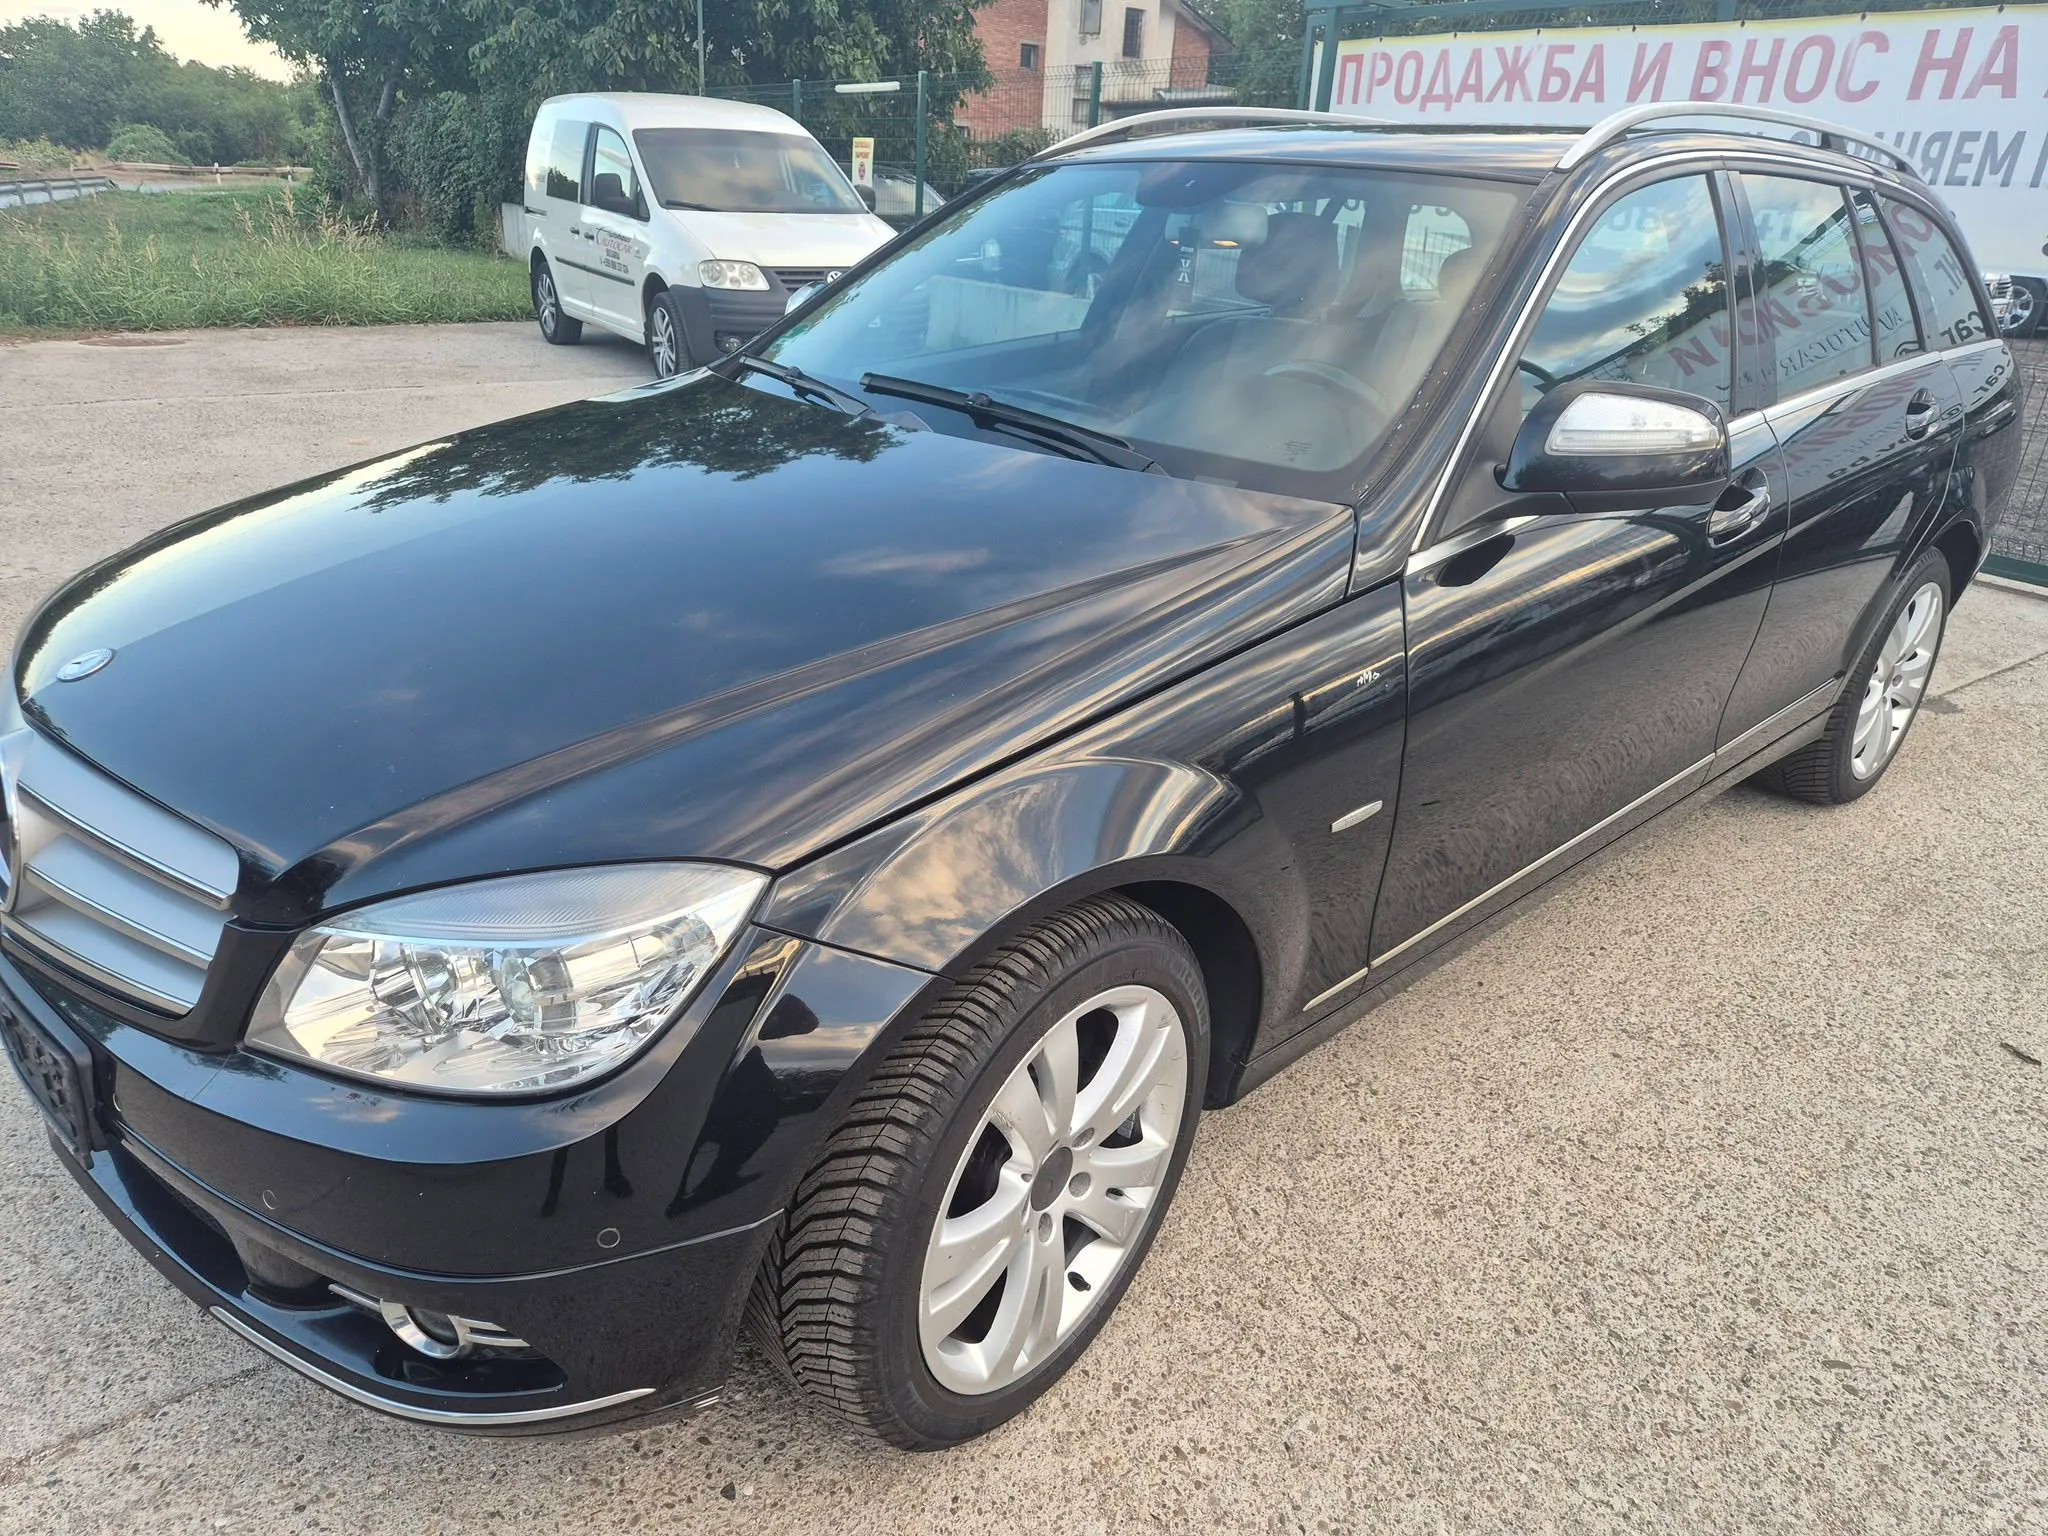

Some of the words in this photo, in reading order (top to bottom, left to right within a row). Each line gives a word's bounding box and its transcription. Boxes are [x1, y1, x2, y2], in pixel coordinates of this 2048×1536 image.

[1336, 44, 1606, 112] ПРОДАЖБА
[1625, 42, 1674, 103] И
[1688, 31, 1890, 104] ВНОС
[1906, 25, 2019, 101] НА
